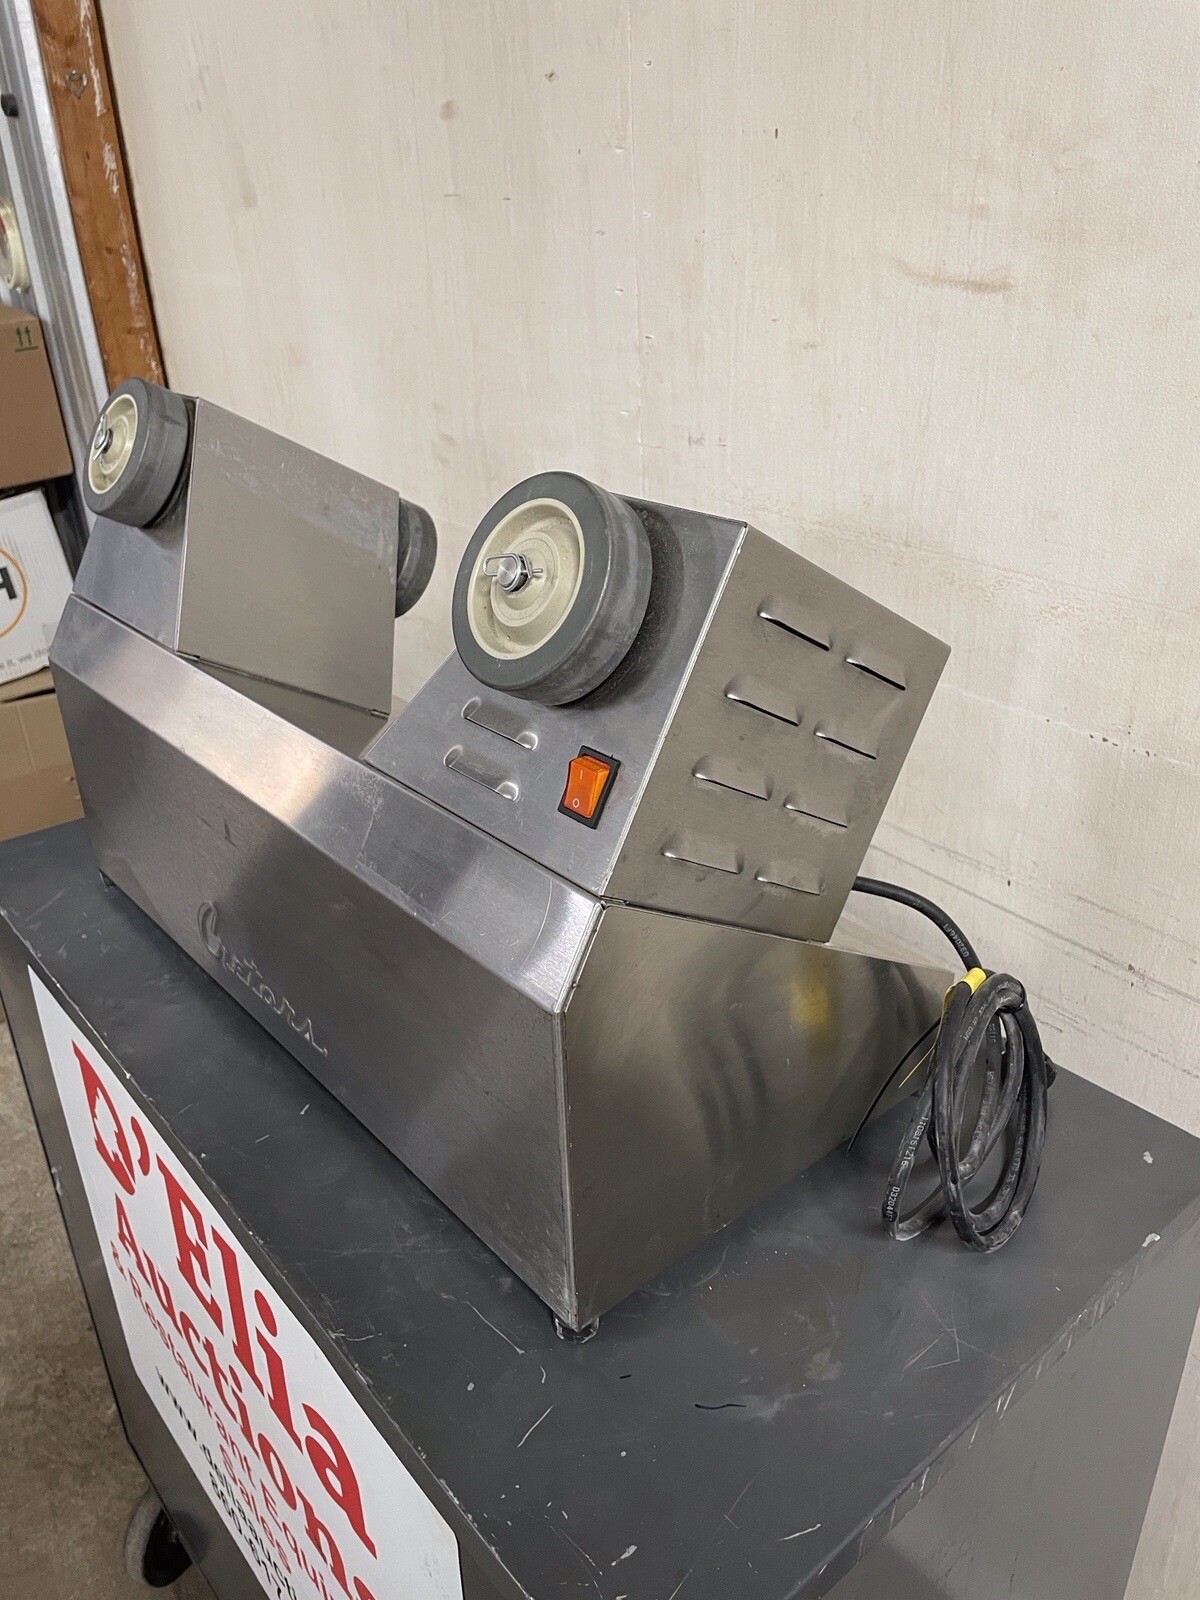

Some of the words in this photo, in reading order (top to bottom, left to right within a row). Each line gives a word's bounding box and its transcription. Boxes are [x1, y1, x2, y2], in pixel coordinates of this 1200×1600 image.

[71, 1039, 377, 1560] D'Elia
[110, 1240, 128, 1281] &
[127, 1268, 256, 1490] Restaurant
[260, 1479, 334, 1600] Equi
[219, 1444, 292, 1574] Sales
